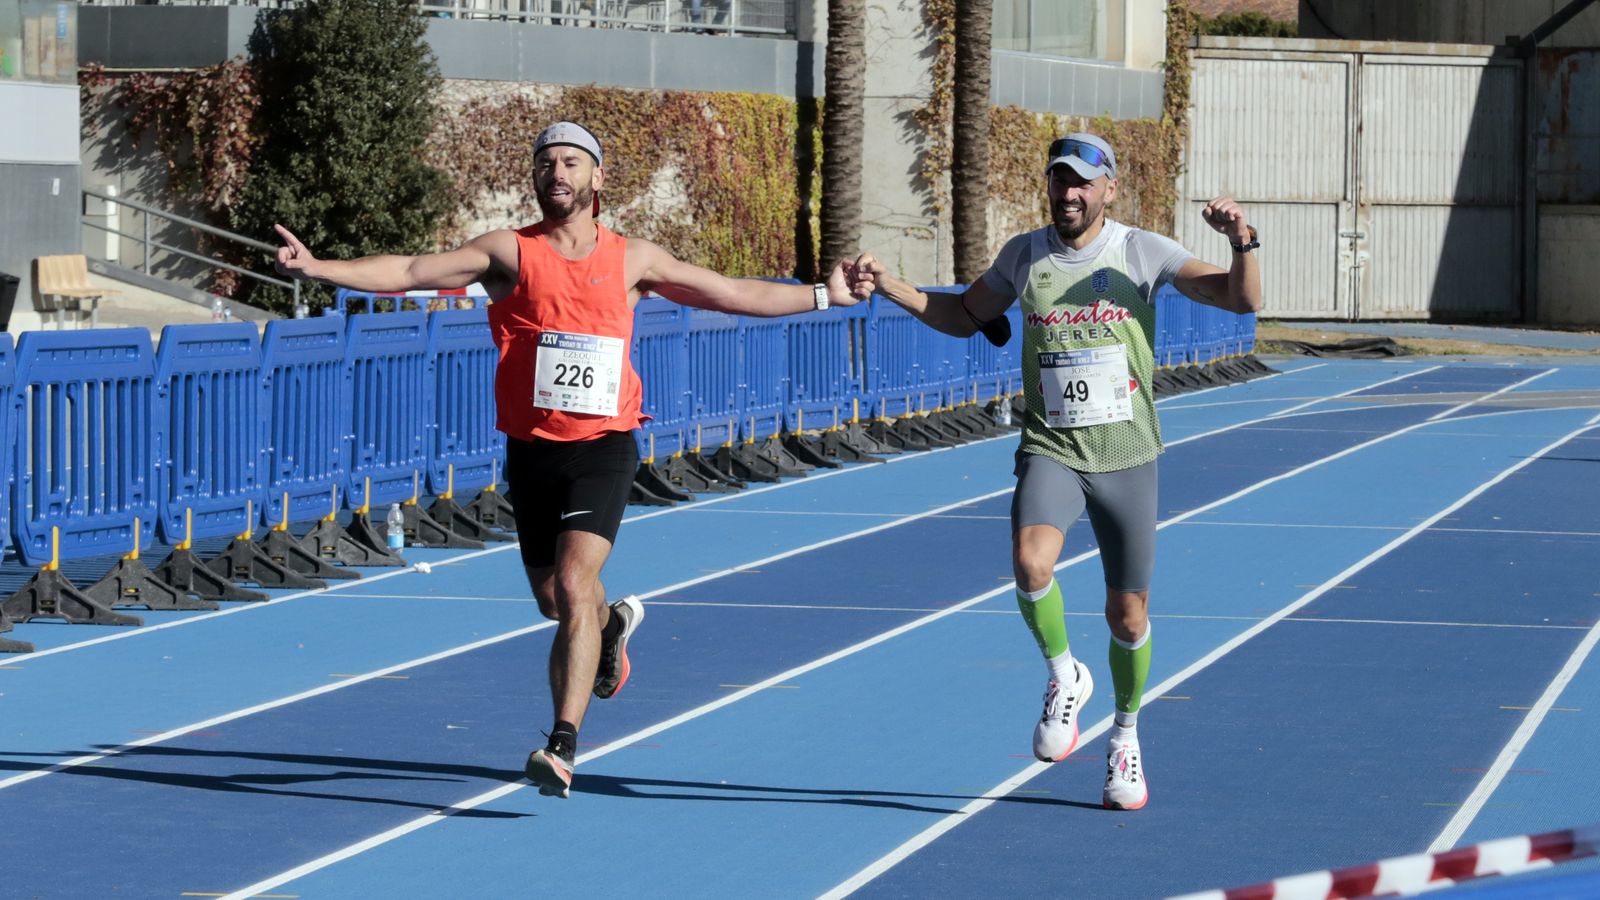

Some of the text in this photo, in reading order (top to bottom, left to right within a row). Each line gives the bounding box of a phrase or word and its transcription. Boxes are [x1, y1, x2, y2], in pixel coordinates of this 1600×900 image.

[1027, 299, 1131, 326] maratón
[541, 333, 558, 345] XXV
[1045, 327, 1114, 342] JEREZ
[1040, 354, 1054, 365] XXV
[553, 363, 594, 389] 226
[1063, 380, 1089, 403] 49
